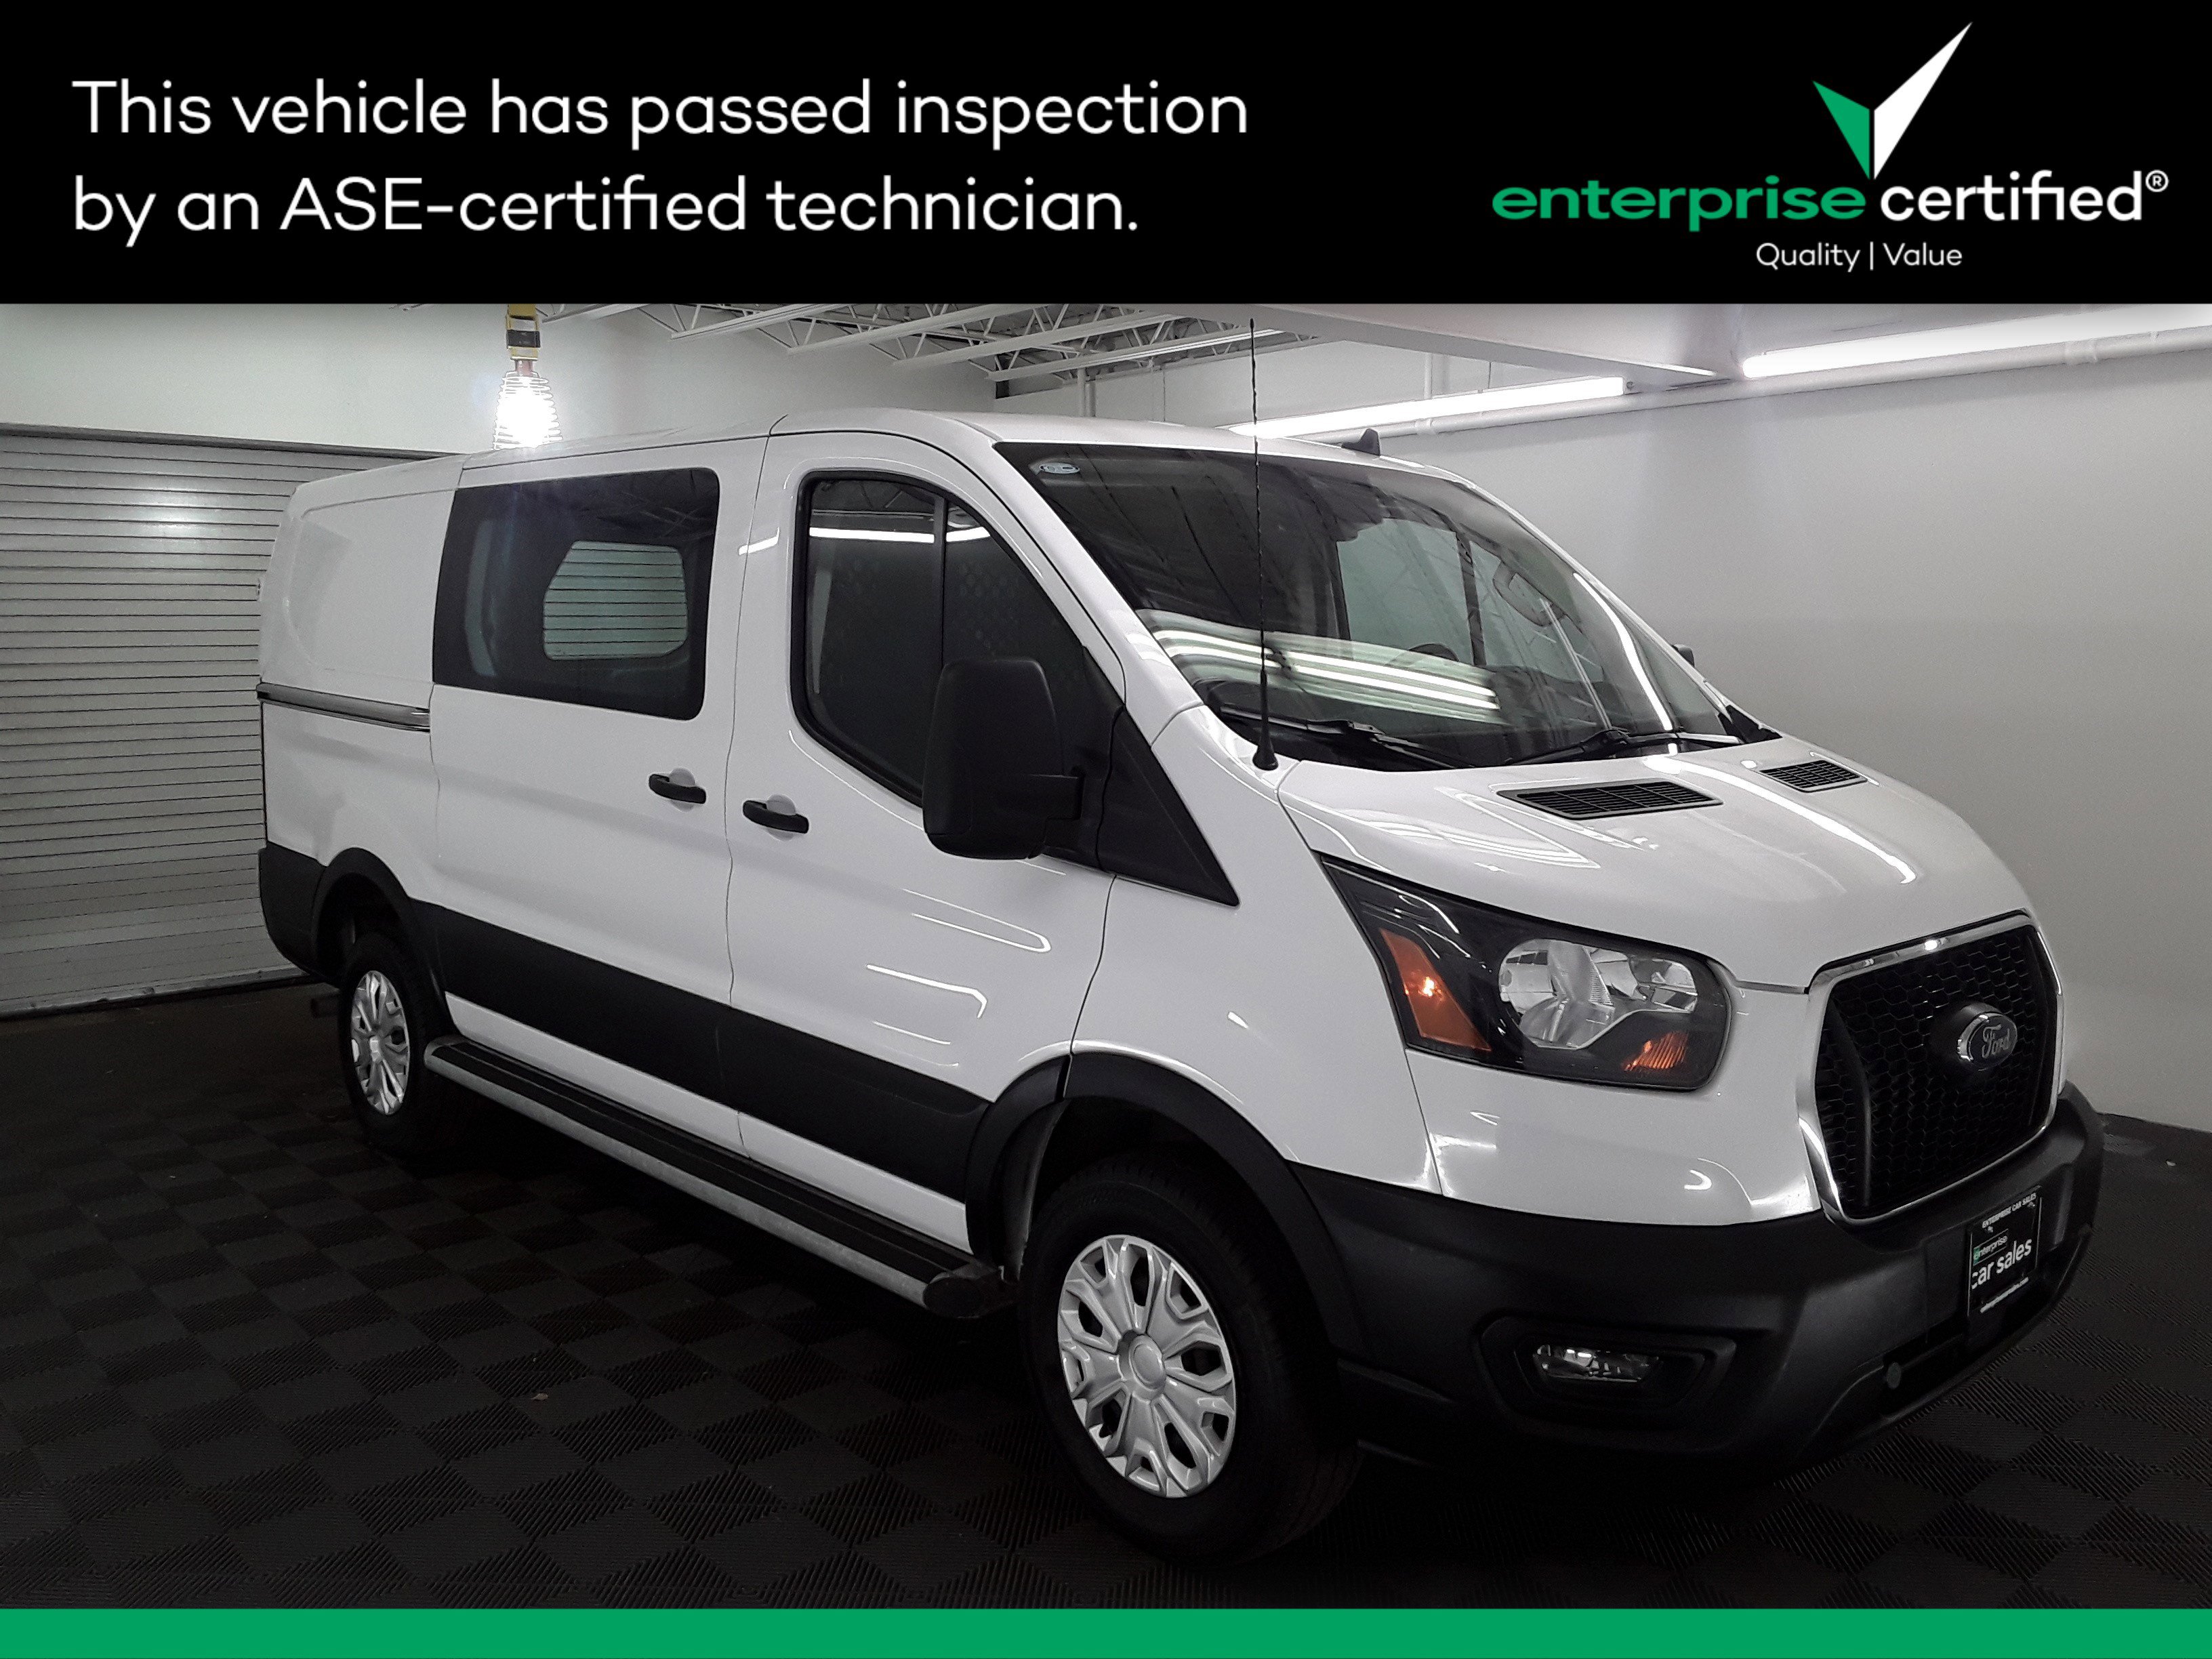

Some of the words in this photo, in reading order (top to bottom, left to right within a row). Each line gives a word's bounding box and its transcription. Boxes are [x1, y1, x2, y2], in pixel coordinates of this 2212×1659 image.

[1981, 1023, 2011, 1059] Ford
[1973, 1234, 2008, 1261] enterprise
[1996, 1238, 2032, 1274] sales
